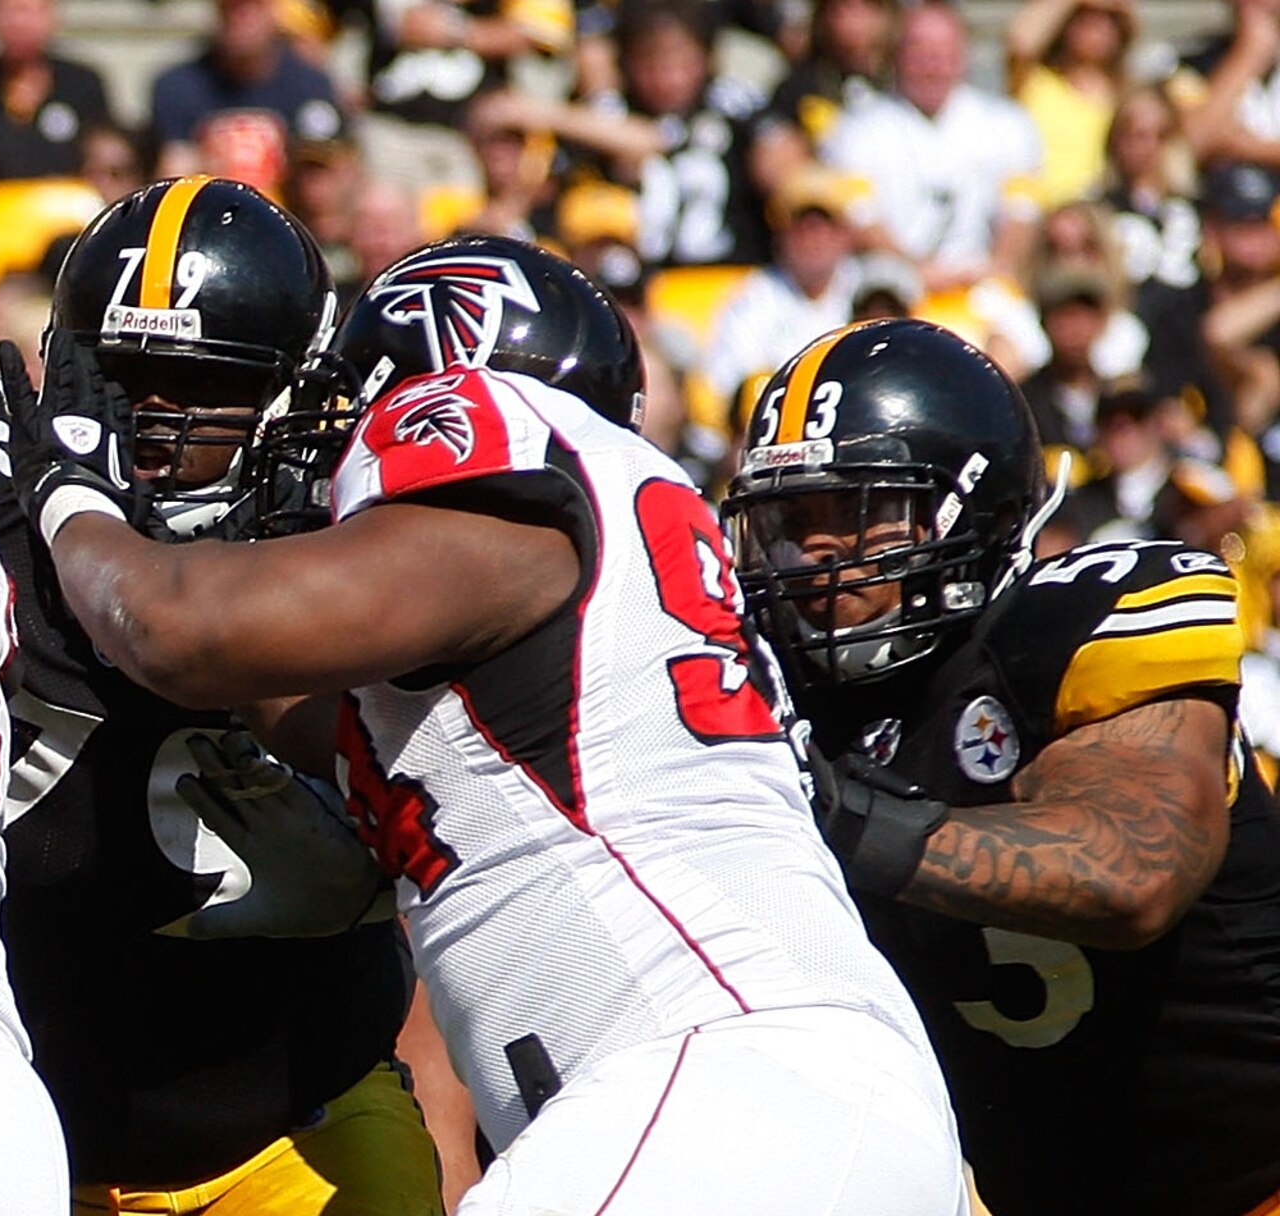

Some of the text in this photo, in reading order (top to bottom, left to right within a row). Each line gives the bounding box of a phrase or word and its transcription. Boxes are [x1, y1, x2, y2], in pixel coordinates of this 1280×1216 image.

[110, 247, 208, 308] 79
[122, 311, 180, 331] Riddell
[757, 380, 844, 446] 53
